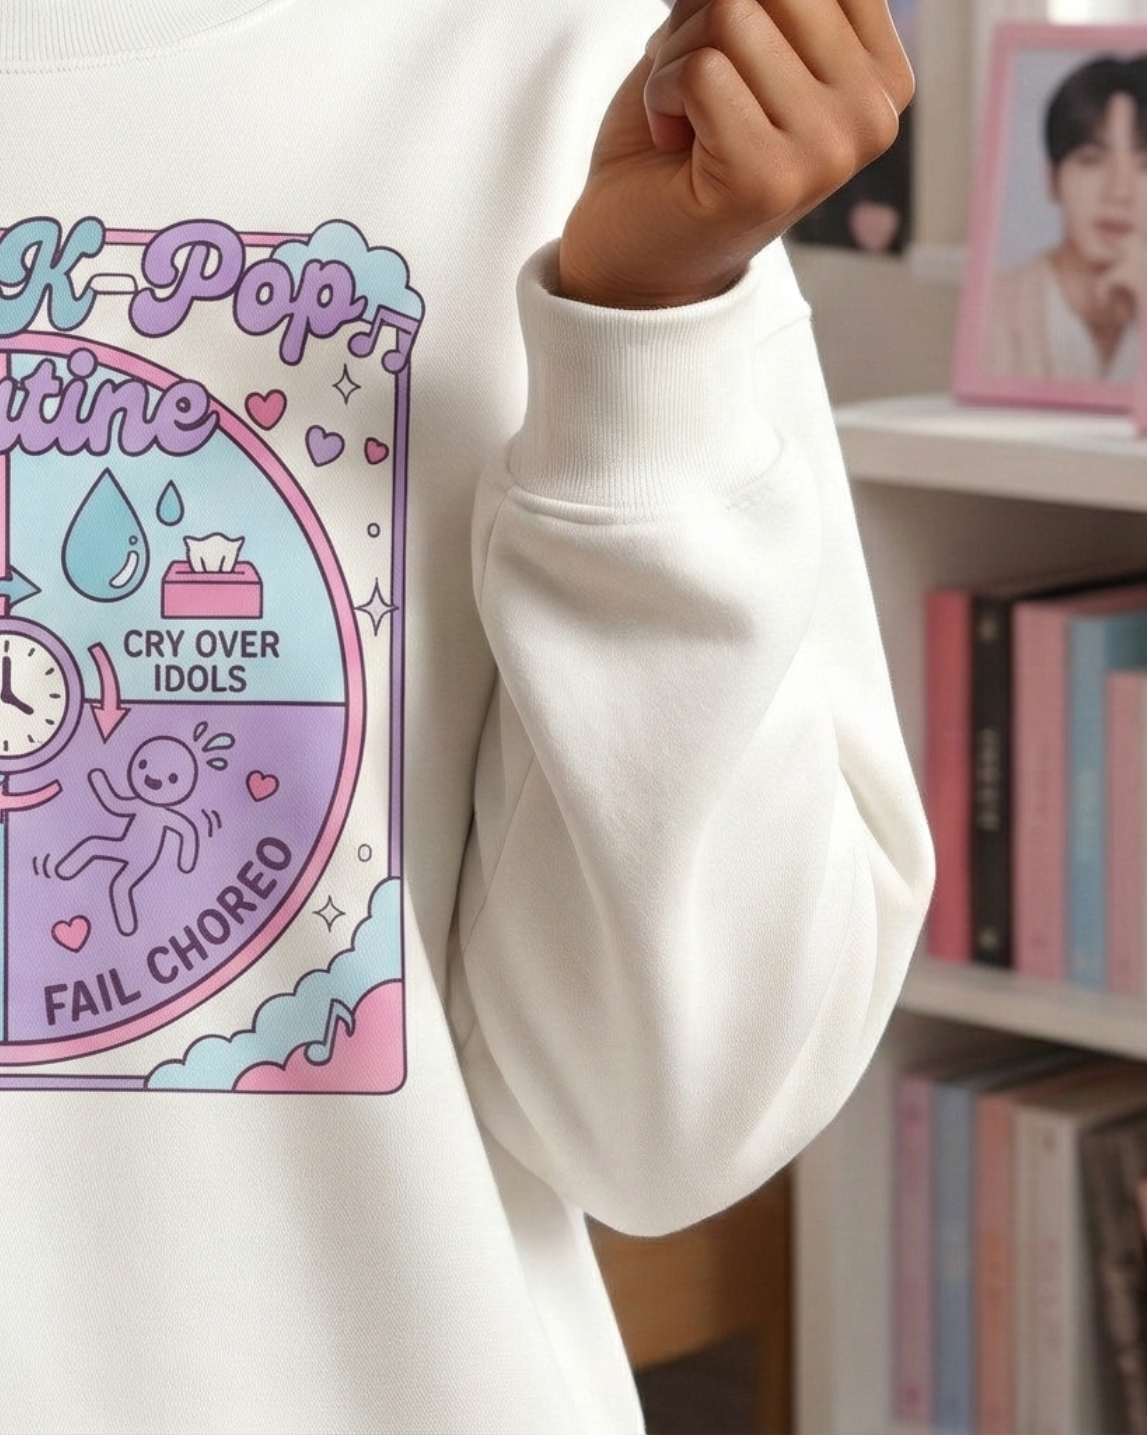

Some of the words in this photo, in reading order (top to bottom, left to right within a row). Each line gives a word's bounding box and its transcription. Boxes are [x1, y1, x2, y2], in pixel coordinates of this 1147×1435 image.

[122, 631, 188, 659] CRY
[195, 630, 280, 658] OVER
[153, 664, 247, 693] IDOLS
[42, 968, 141, 1025] FAIL
[146, 837, 293, 986] CHOREO
